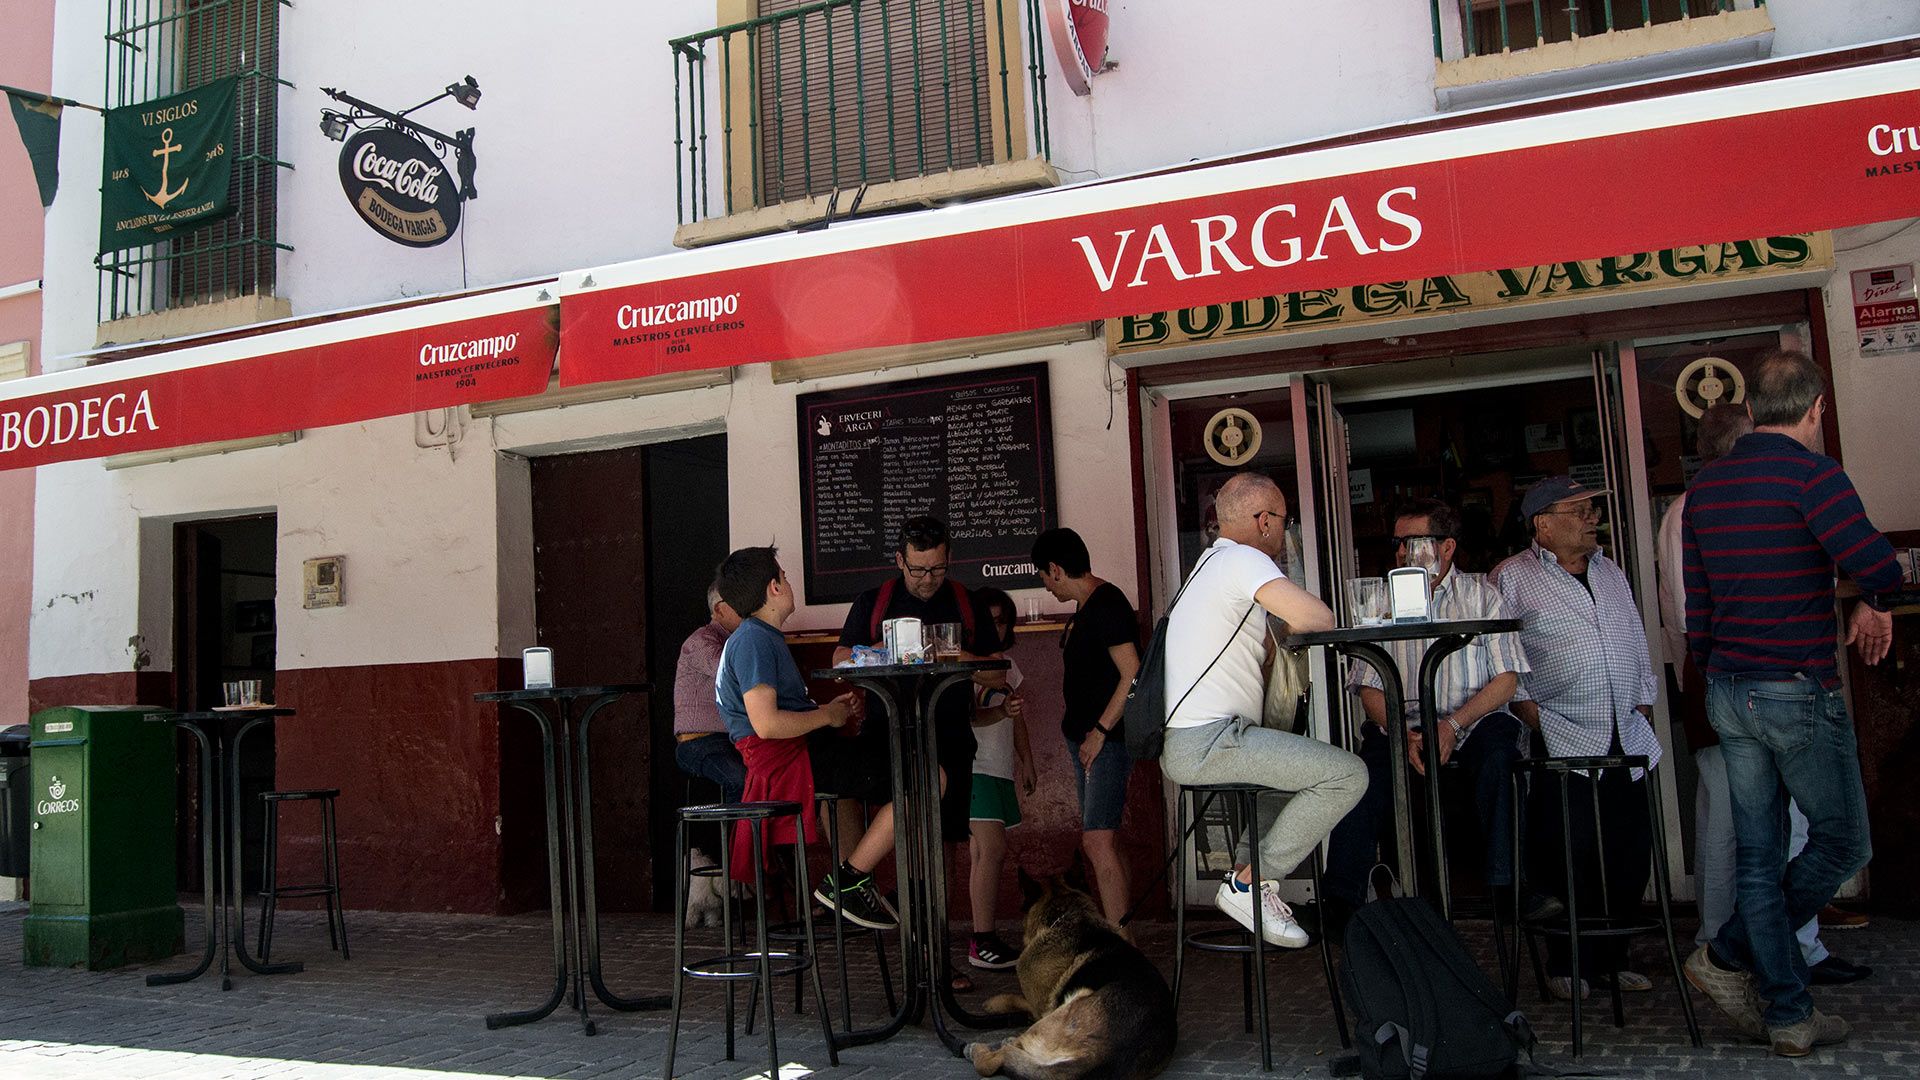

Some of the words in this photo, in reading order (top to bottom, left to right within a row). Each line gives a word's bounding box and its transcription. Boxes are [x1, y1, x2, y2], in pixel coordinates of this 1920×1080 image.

[142, 113, 153, 126] VI
[156, 100, 198, 124] SIGLOS
[369, 198, 404, 233] BODEGA
[405, 217, 437, 236] VARGAS
[1072, 186, 1423, 292] VARGAS
[1864, 280, 1905, 301] Direct
[617, 294, 738, 330] Cruzcampo
[1860, 305, 1916, 319] Alarma
[613, 331, 670, 346] MAESTROS
[674, 321, 745, 338] CERVECEROS
[420, 333, 517, 366] Cruzcampo
[666, 344, 691, 354] 1904
[416, 368, 461, 381] MAESTROS
[464, 357, 520, 373] CERVECEROS
[456, 378, 476, 388] 1904
[0, 389, 159, 452] BODEGA
[950, 529, 993, 539] CABRILLAS
[1013, 527, 1038, 536] SALSA
[982, 563, 1039, 577] Cruzcamp
[38, 799, 79, 815] CORREOS
